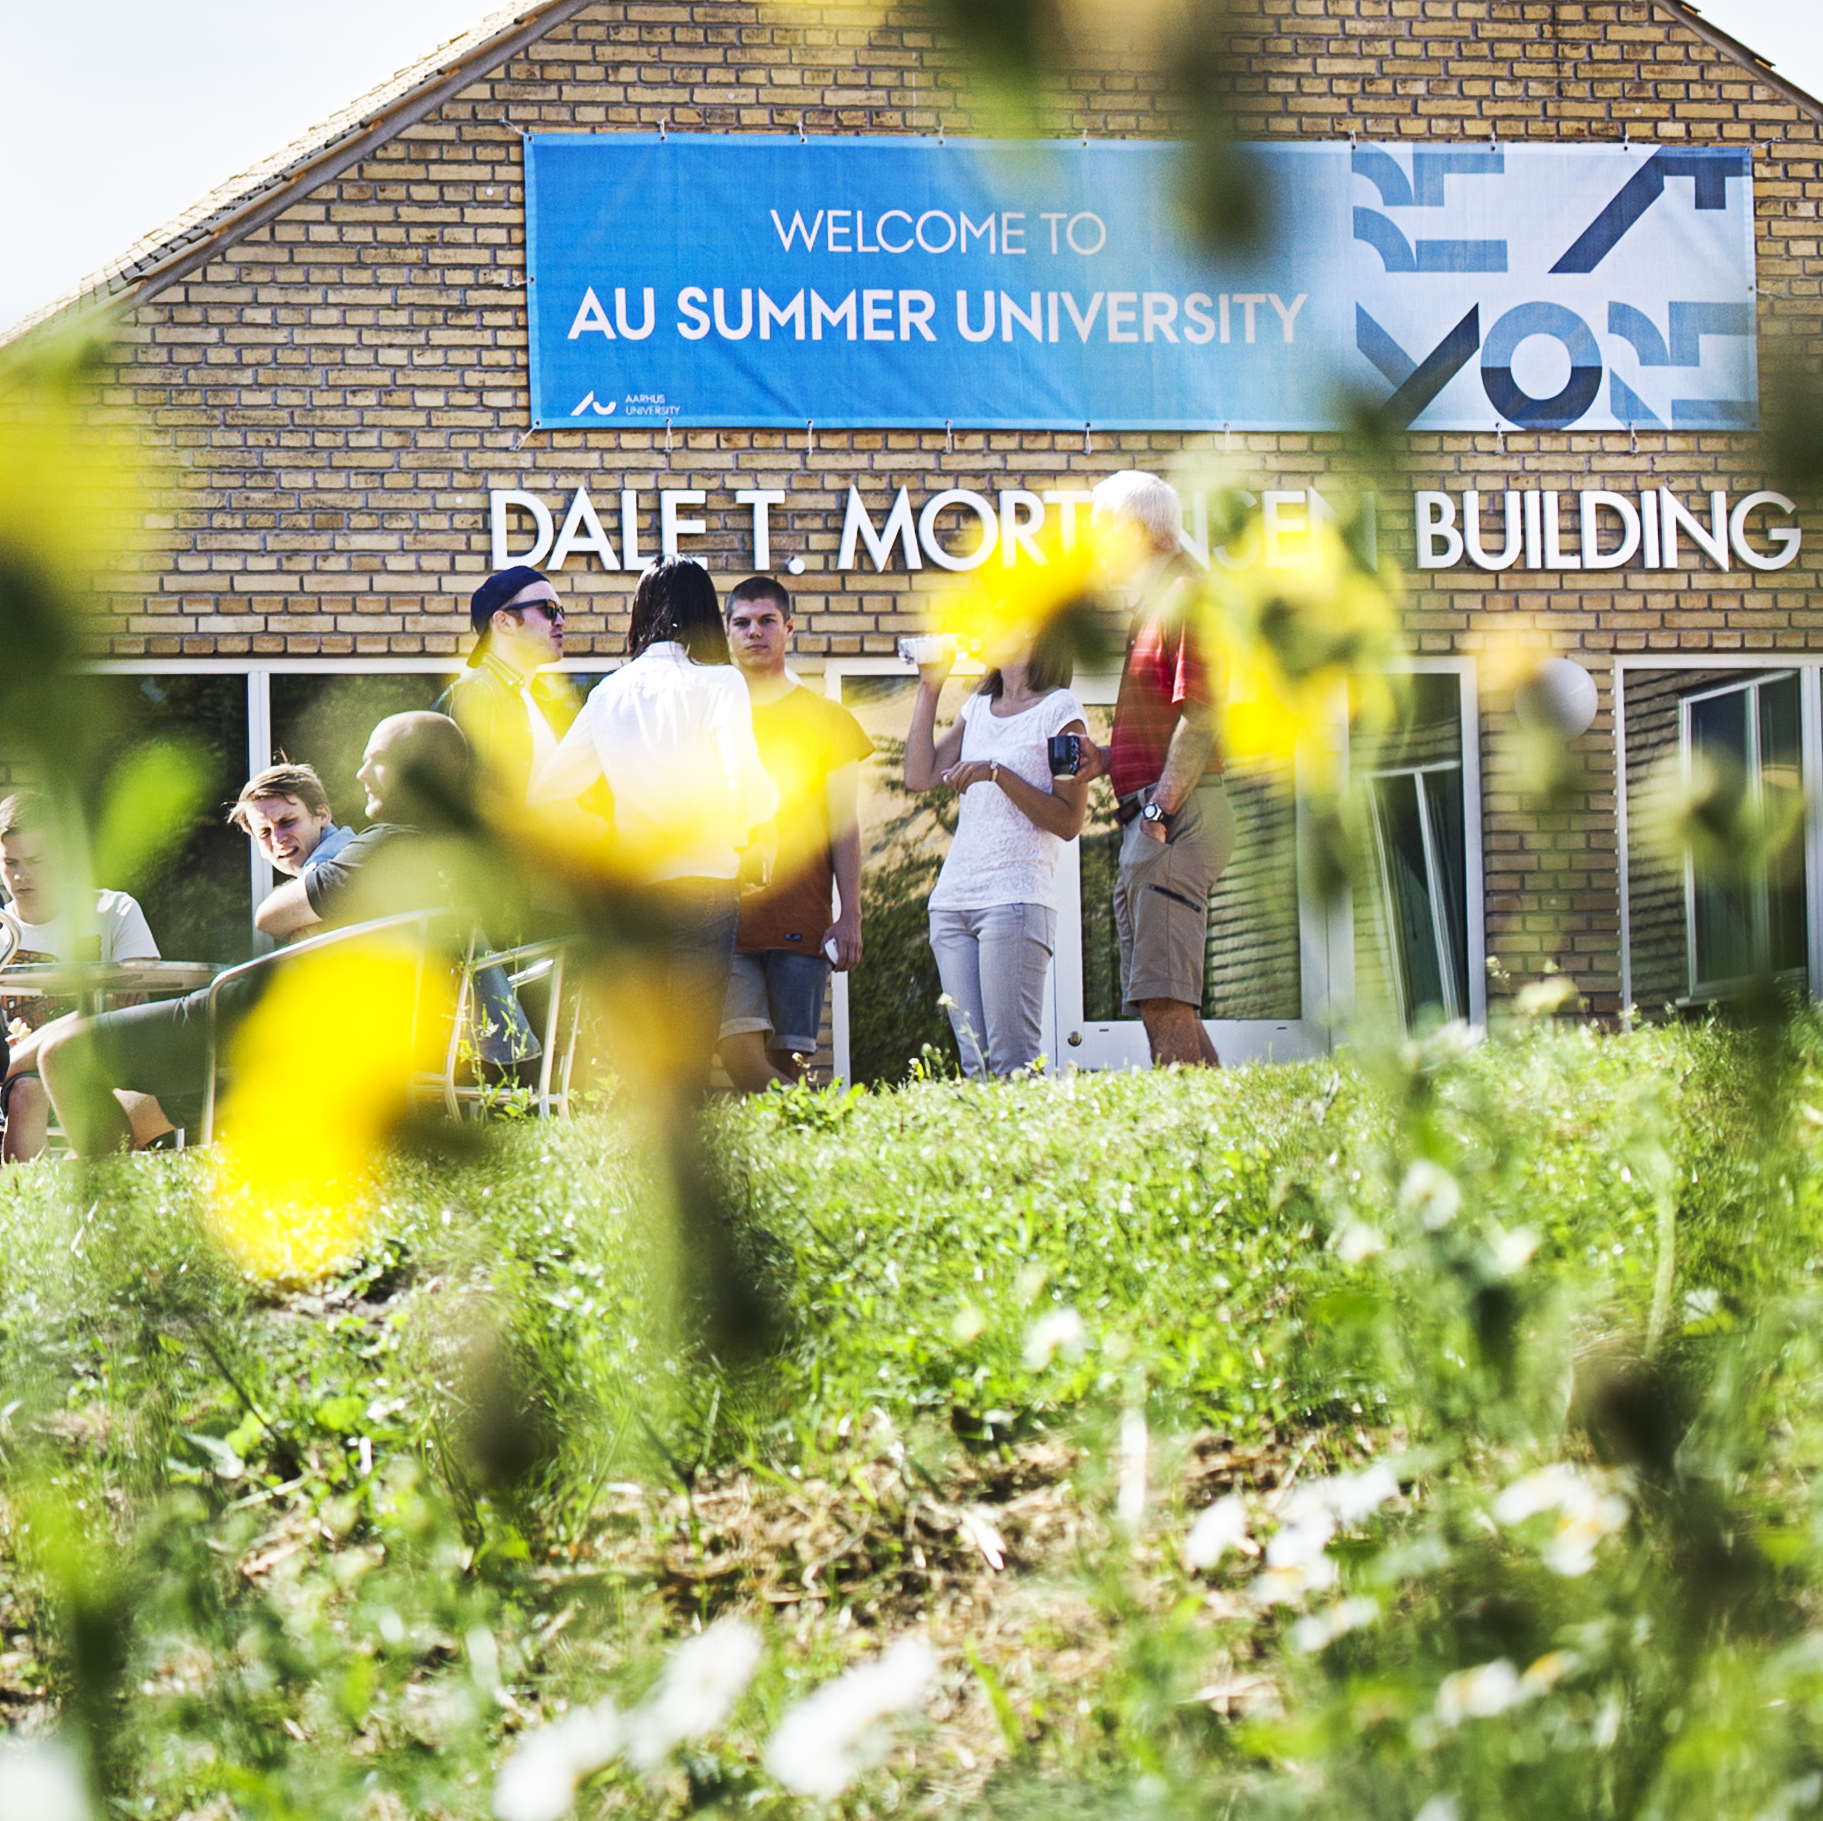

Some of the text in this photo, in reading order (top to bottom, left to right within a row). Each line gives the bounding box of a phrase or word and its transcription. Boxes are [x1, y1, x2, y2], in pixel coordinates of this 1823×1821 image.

[769, 209, 1107, 256] WELCOME TO
[566, 285, 1309, 345] AU SUMMER UNIVERSITY
[624, 393, 666, 405] AARHUS
[624, 404, 681, 417] UNIVERSITY
[490, 484, 1802, 575] DALE T. MORTNSEN BUILDING
